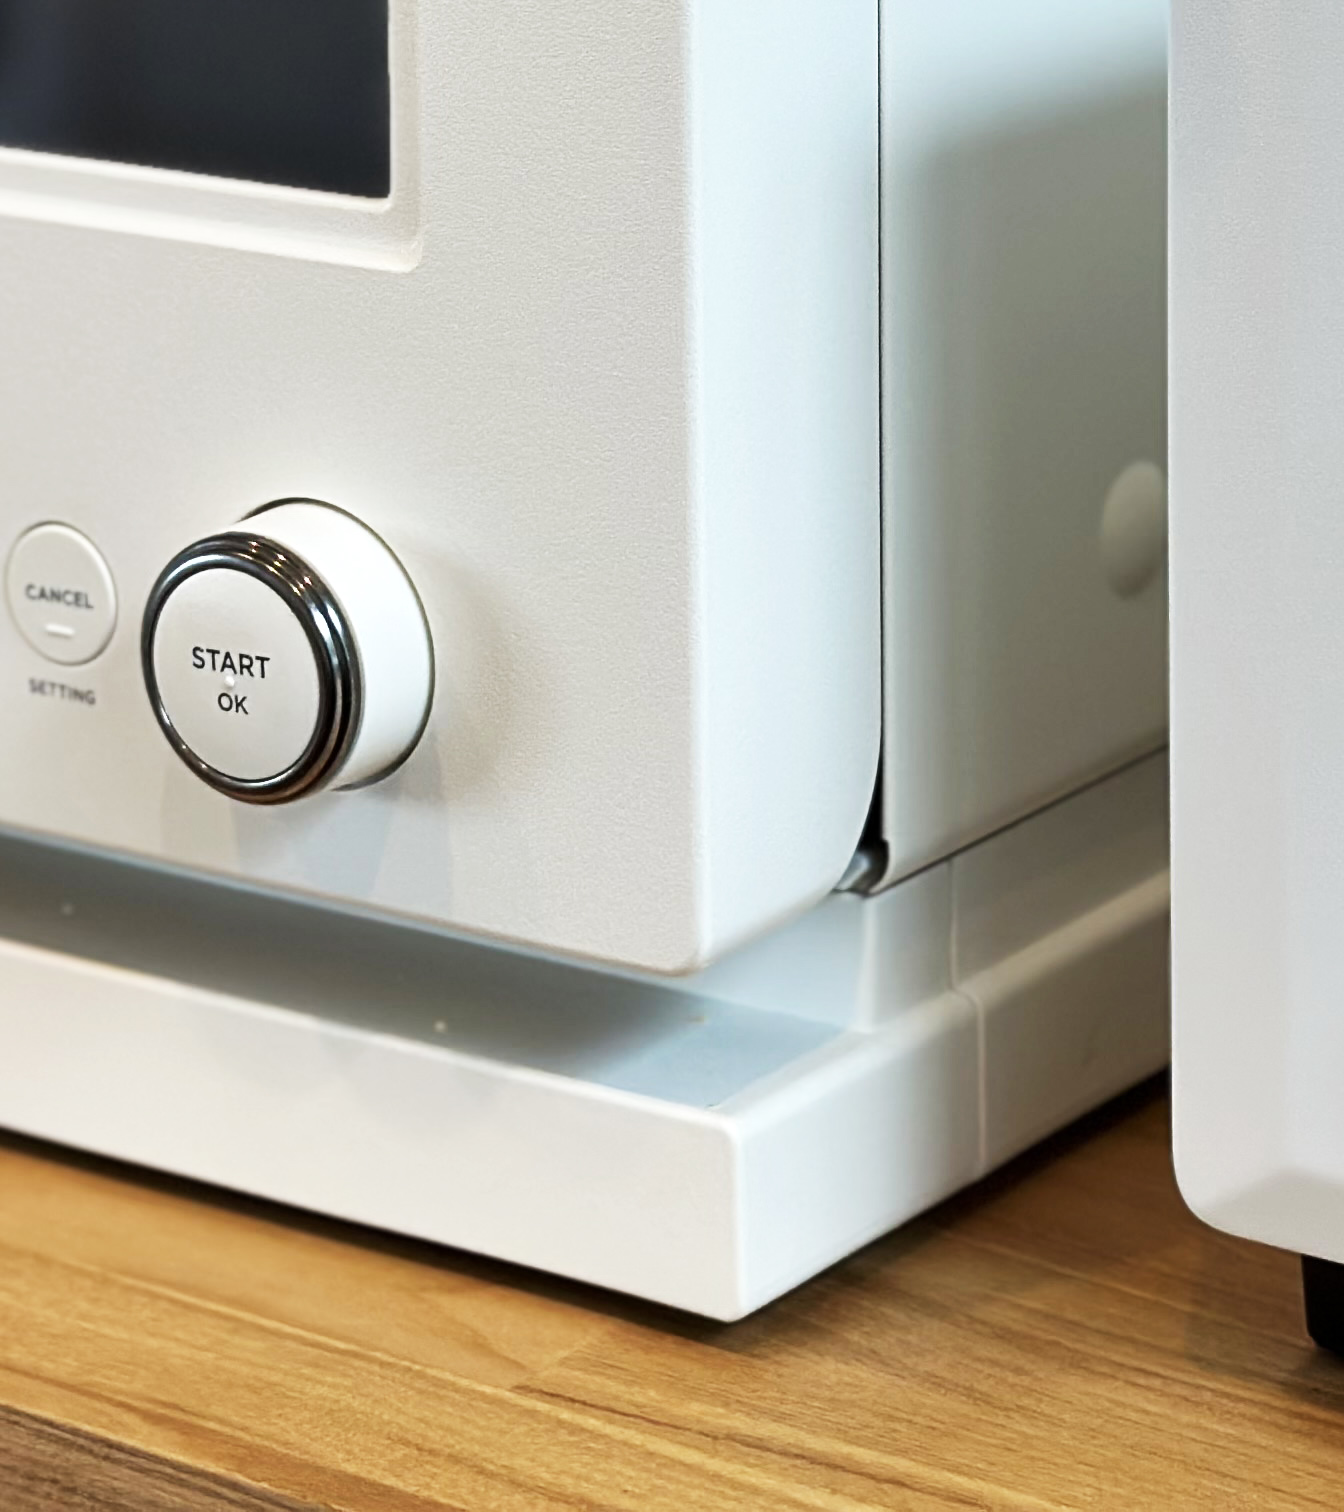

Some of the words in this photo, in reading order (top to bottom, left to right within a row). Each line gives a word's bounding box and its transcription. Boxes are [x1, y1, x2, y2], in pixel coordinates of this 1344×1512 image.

[24, 582, 95, 610] CANCEL
[191, 646, 271, 680] START
[27, 677, 97, 707] SETTING
[216, 691, 250, 716] OK
